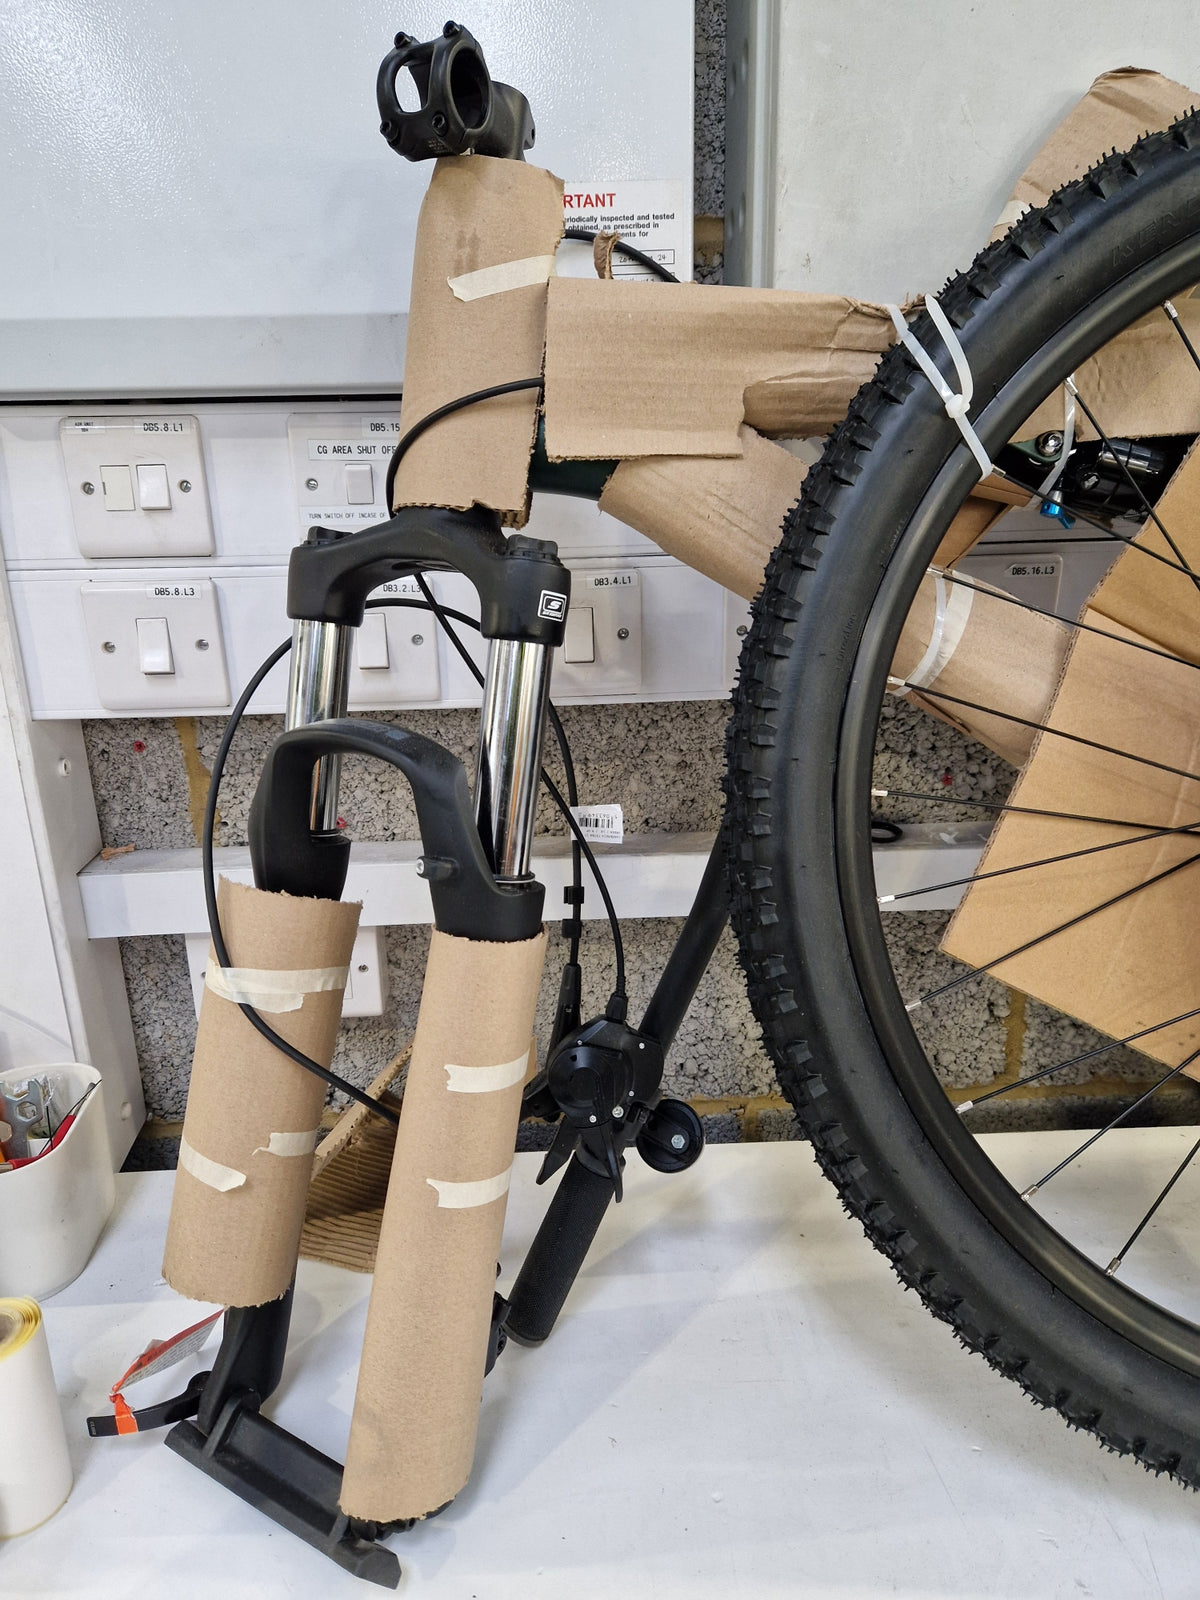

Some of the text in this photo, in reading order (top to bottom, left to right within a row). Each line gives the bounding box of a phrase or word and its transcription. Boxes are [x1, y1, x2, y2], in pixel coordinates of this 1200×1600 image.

[600, 214, 634, 222] inspected
[614, 222, 650, 231] prescribed
[143, 423, 184, 432] DB5.8.L1
[317, 445, 328, 454] CG
[332, 445, 352, 454] AREA
[357, 445, 377, 454] SHUT
[1011, 566, 1055, 575] DB5.16.L3
[594, 576, 631, 586] DB3.4.L1
[154, 587, 195, 596] DB5.8.L3
[383, 584, 421, 593] DB3.2.L3
